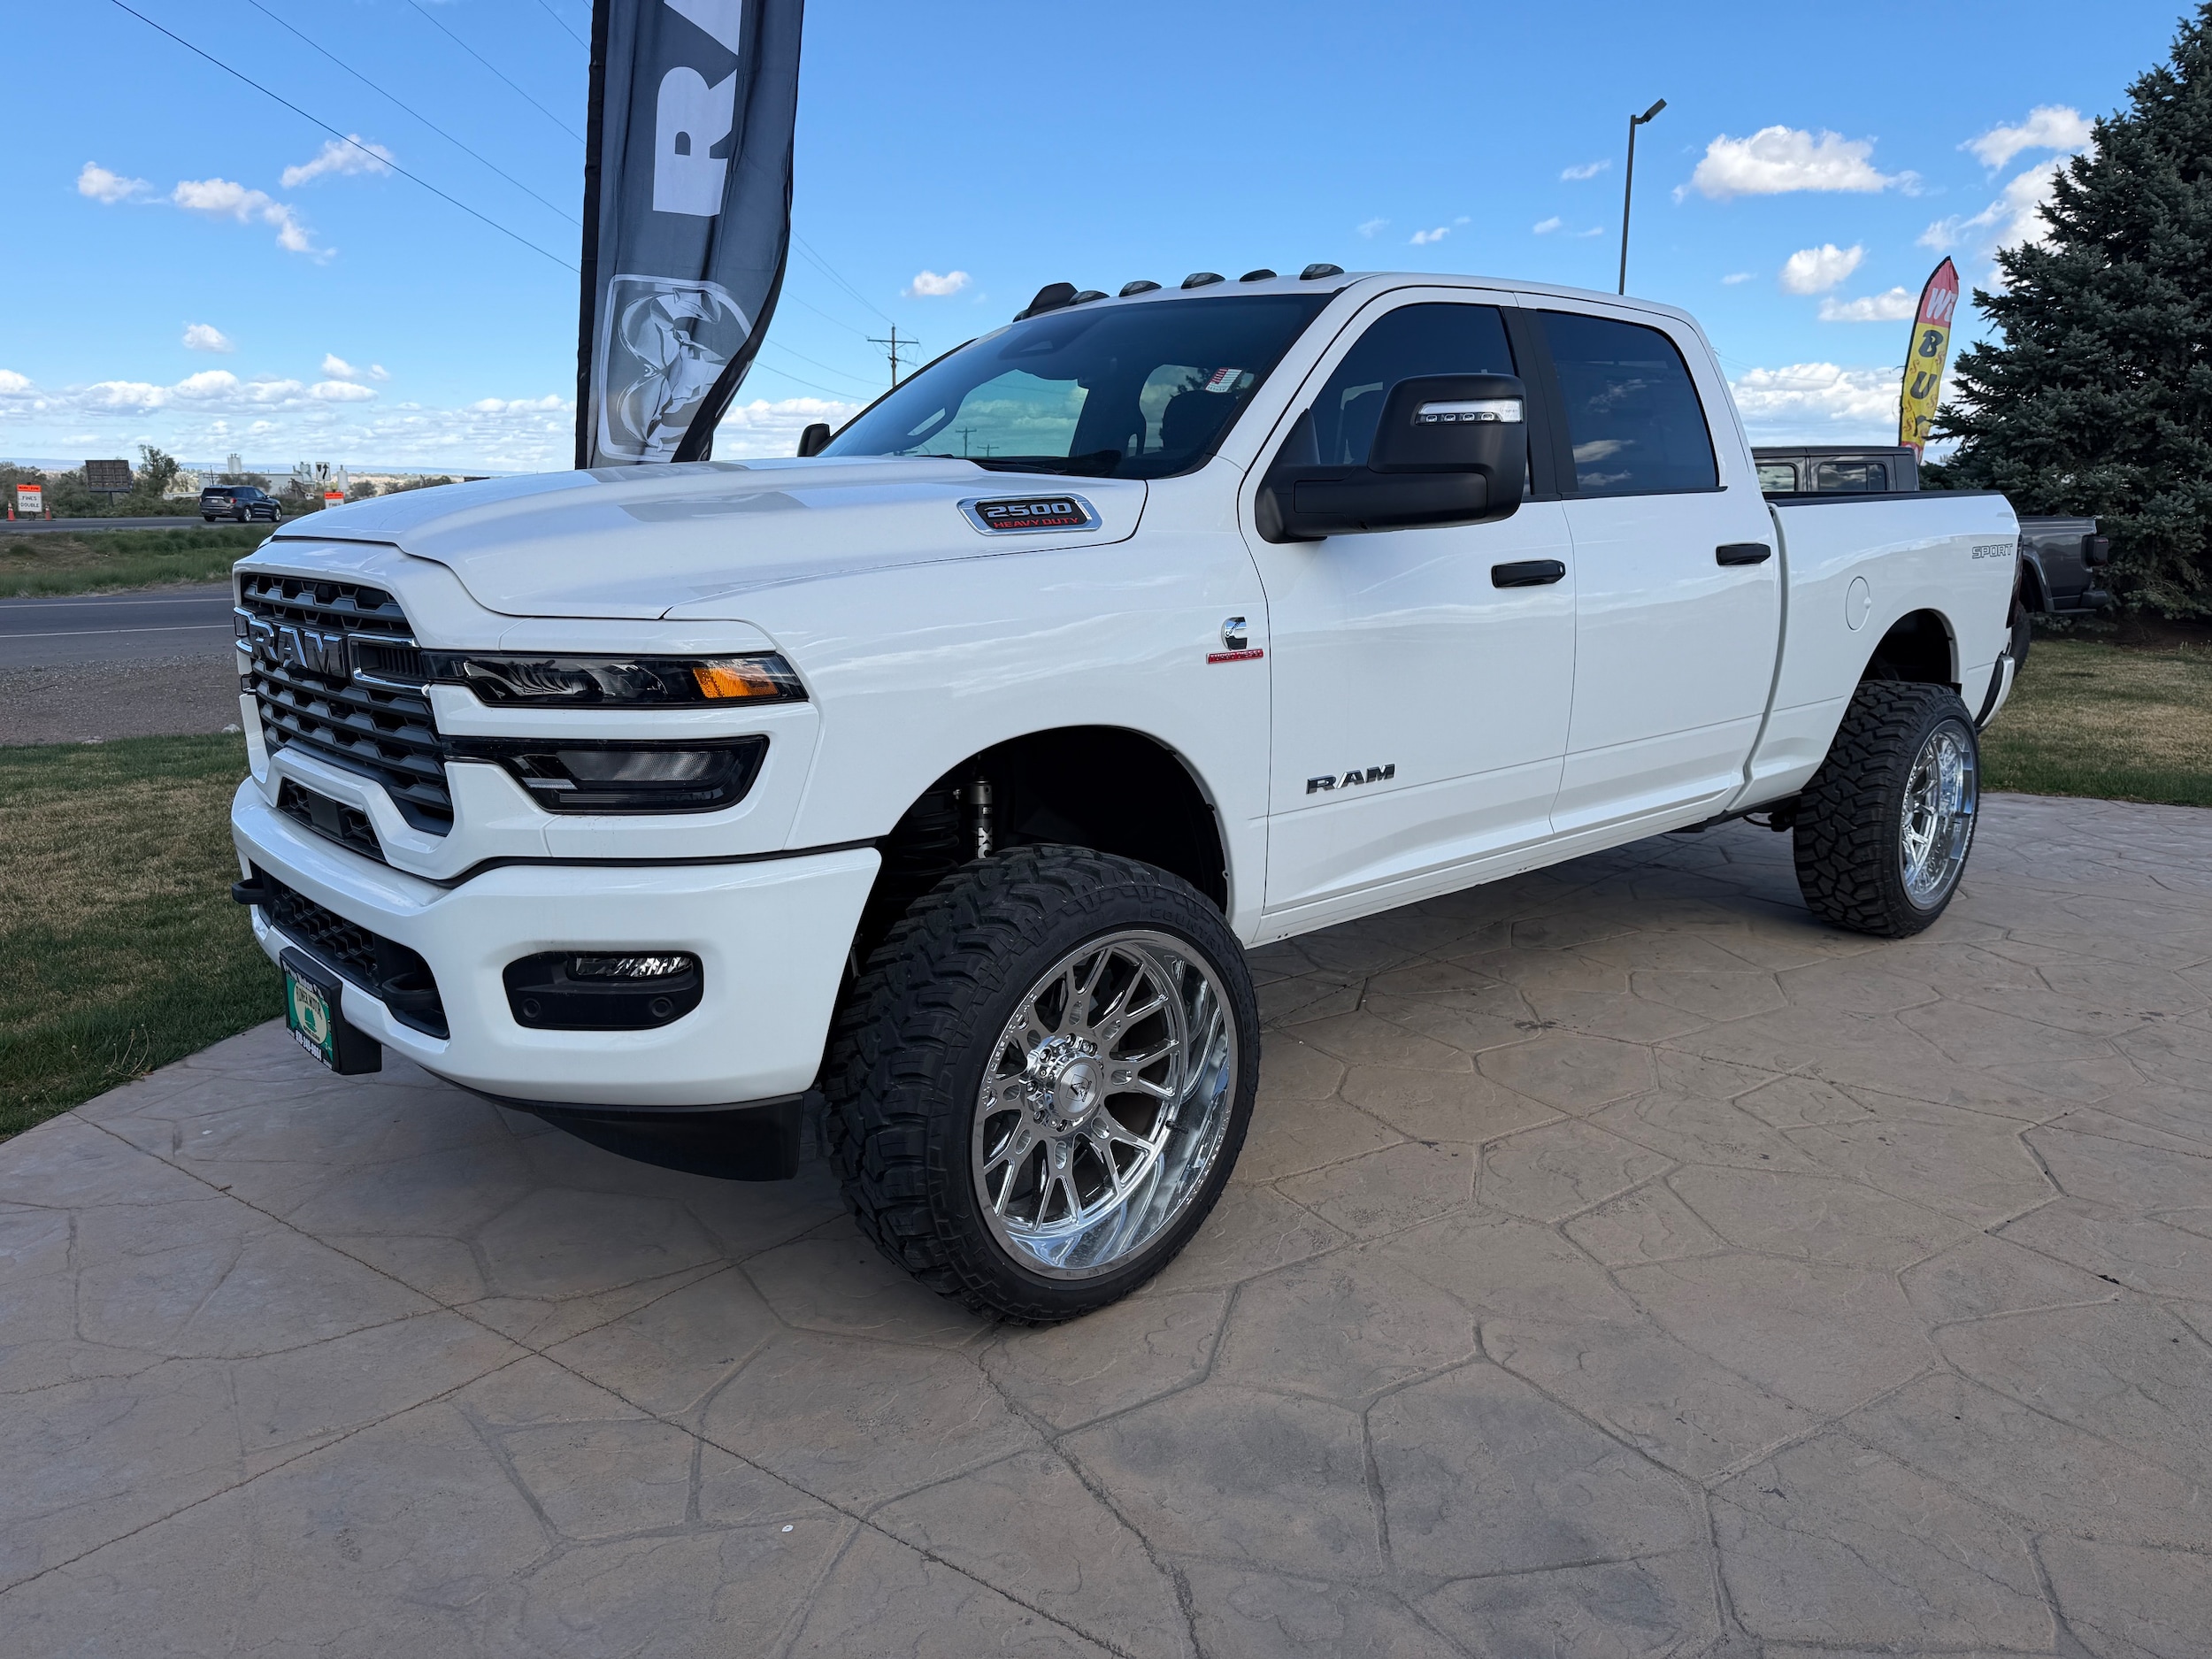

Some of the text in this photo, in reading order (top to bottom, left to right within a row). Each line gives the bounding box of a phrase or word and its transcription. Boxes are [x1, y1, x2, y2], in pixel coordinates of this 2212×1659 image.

[984, 503, 1072, 518] 2500
[994, 518, 1040, 528] HEAVY
[1971, 542, 2014, 559] SPORT
[250, 619, 347, 678] RAM
[1305, 764, 1395, 795] RAM
[1148, 906, 1227, 960] COUNTRY
[955, 1204, 1001, 1279] FURY
